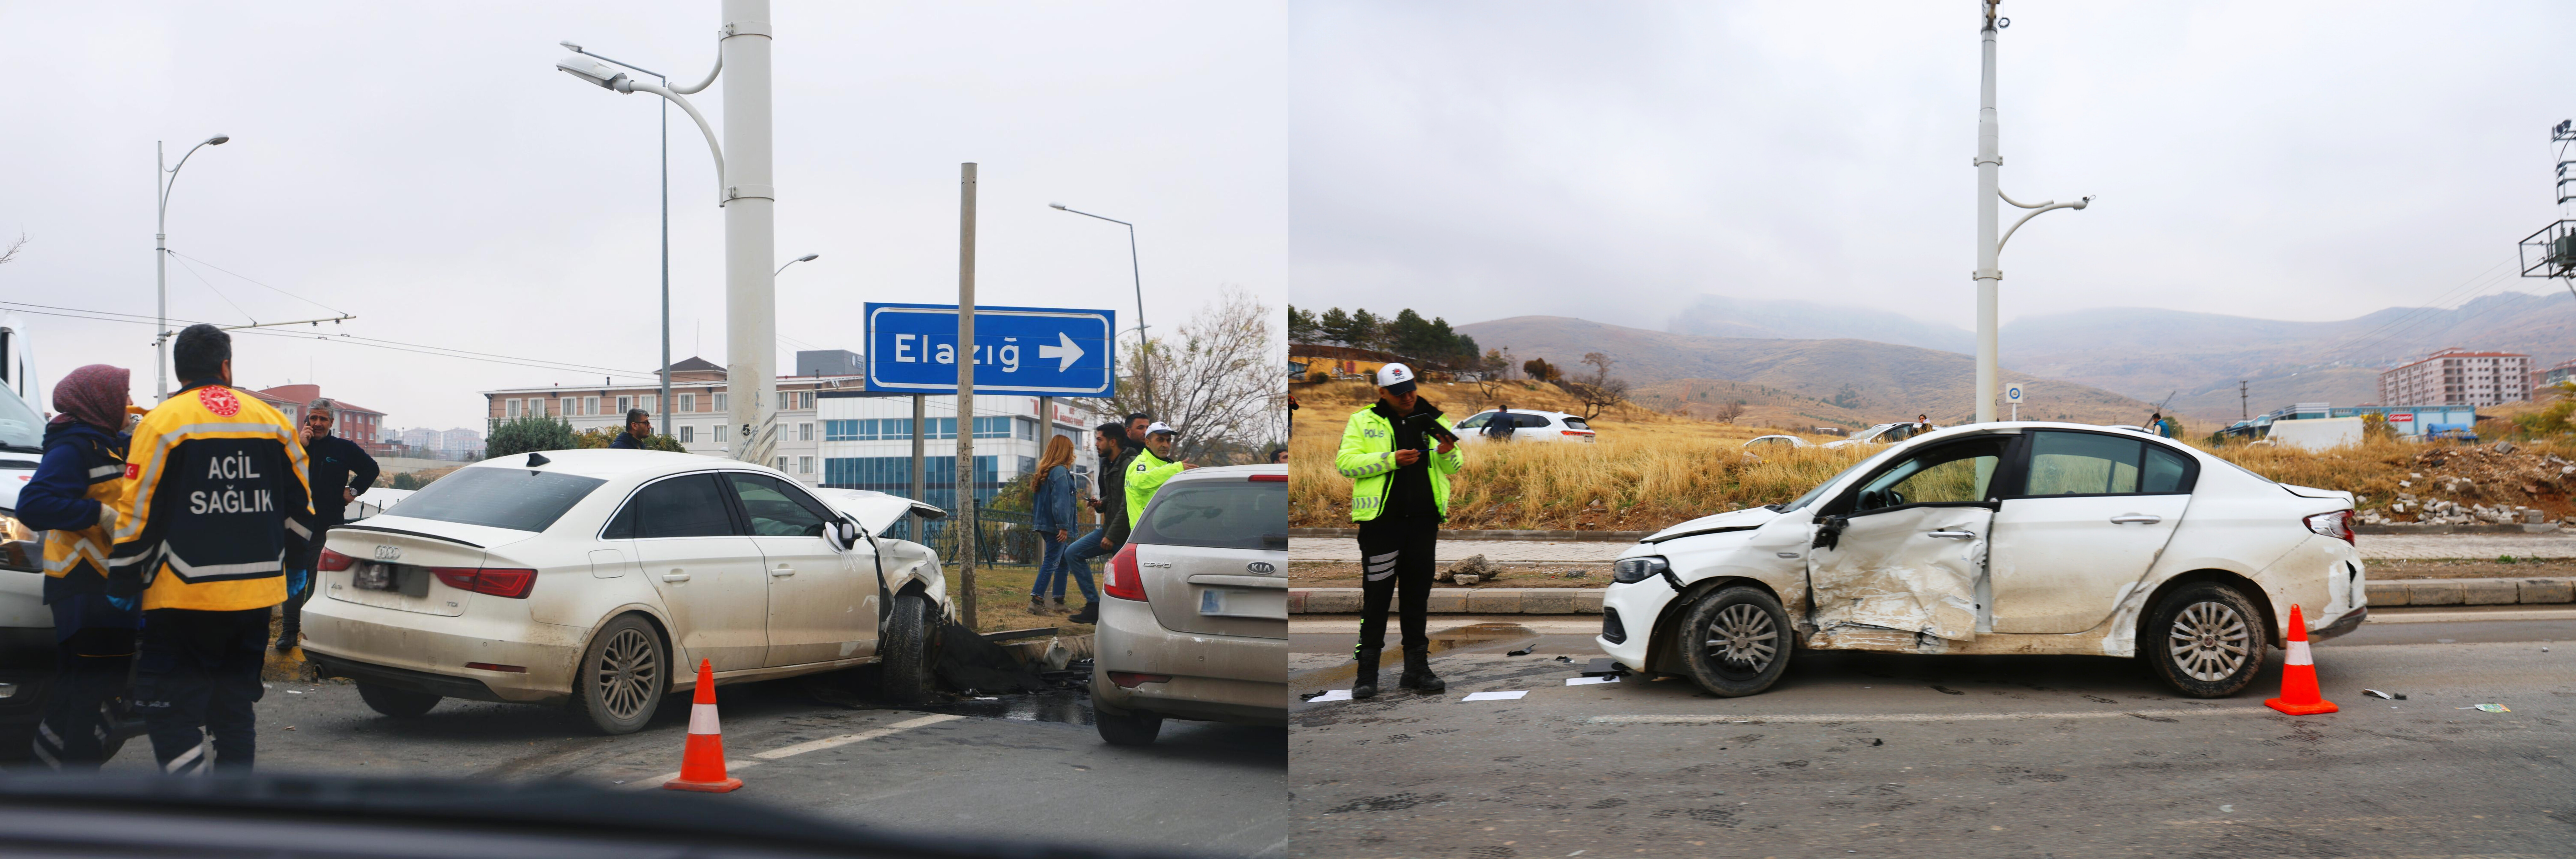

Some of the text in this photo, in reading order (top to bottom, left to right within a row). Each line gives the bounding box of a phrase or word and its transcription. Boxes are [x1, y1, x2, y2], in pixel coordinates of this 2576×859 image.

[743, 424, 750, 436] 5
[1364, 428, 1384, 438] POLS
[208, 450, 260, 479] ACİL
[190, 484, 274, 515] SAĞLIK
[1252, 564, 1271, 572] KIA
